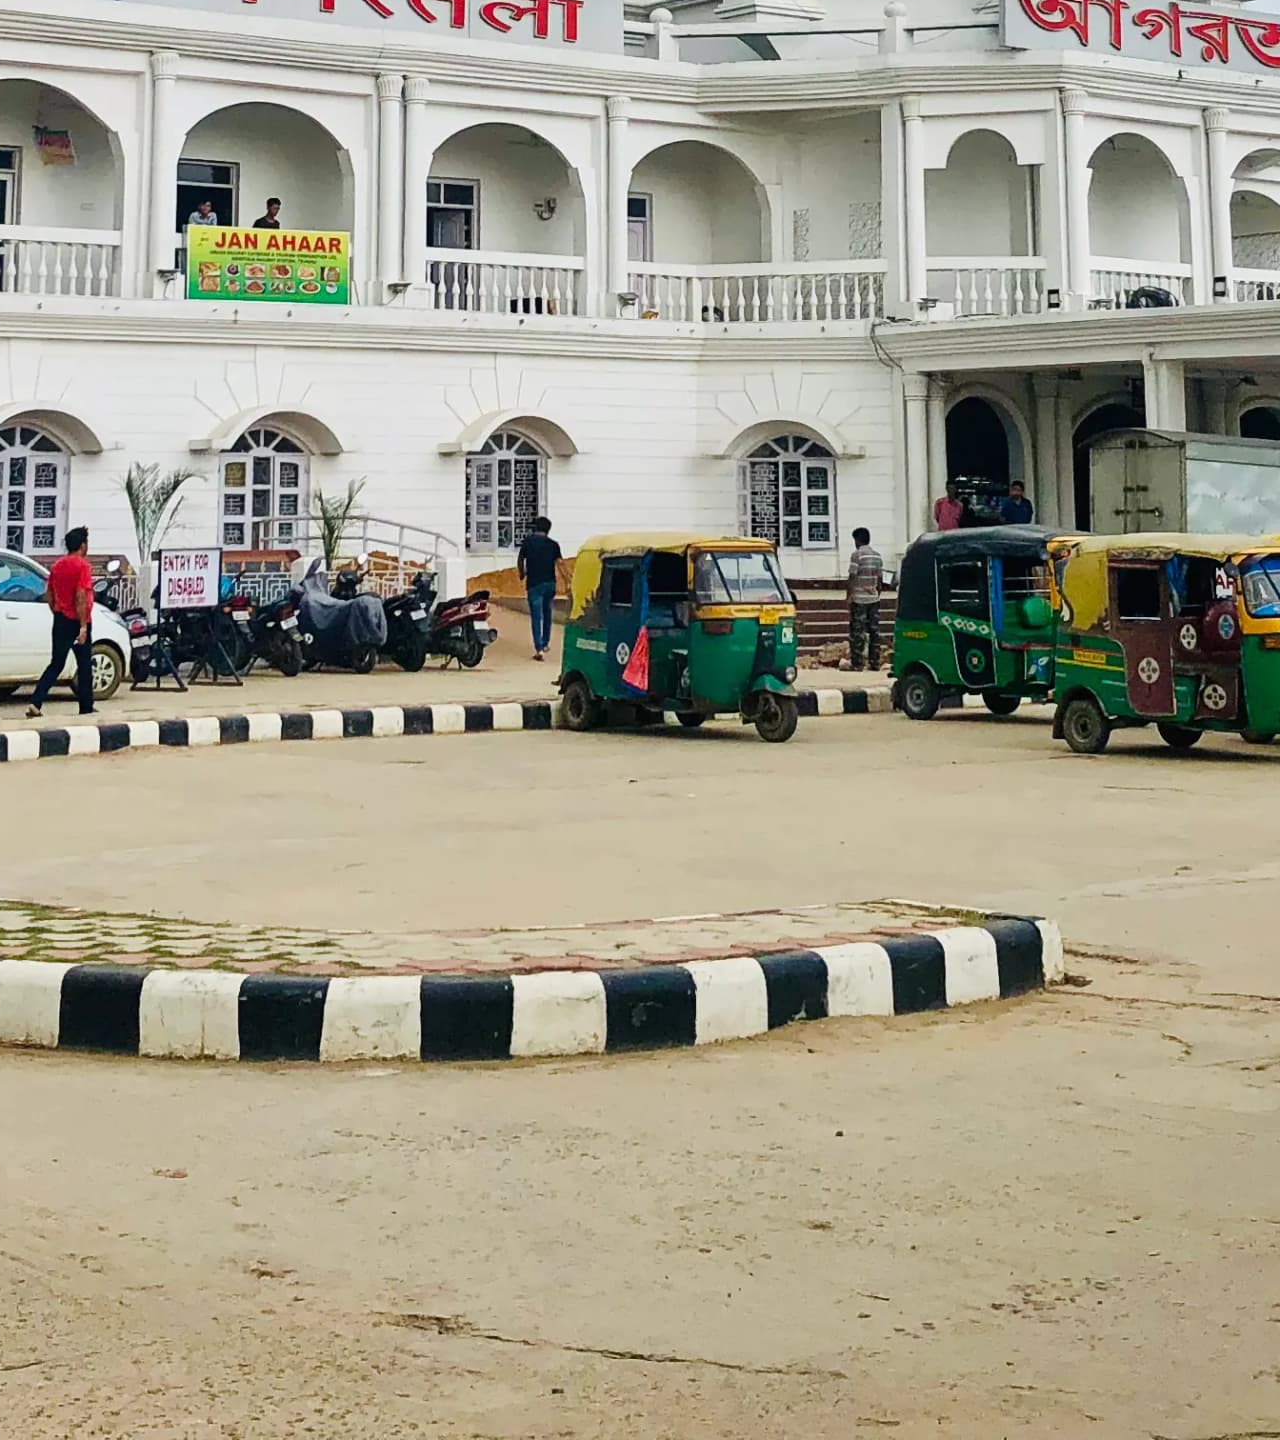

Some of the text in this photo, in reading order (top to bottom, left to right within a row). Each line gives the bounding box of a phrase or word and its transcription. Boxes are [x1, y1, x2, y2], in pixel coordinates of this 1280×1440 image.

[214, 232, 258, 250] JAN
[266, 234, 342, 253] AHAAR
[164, 554, 209, 571] ENTRY FOR
